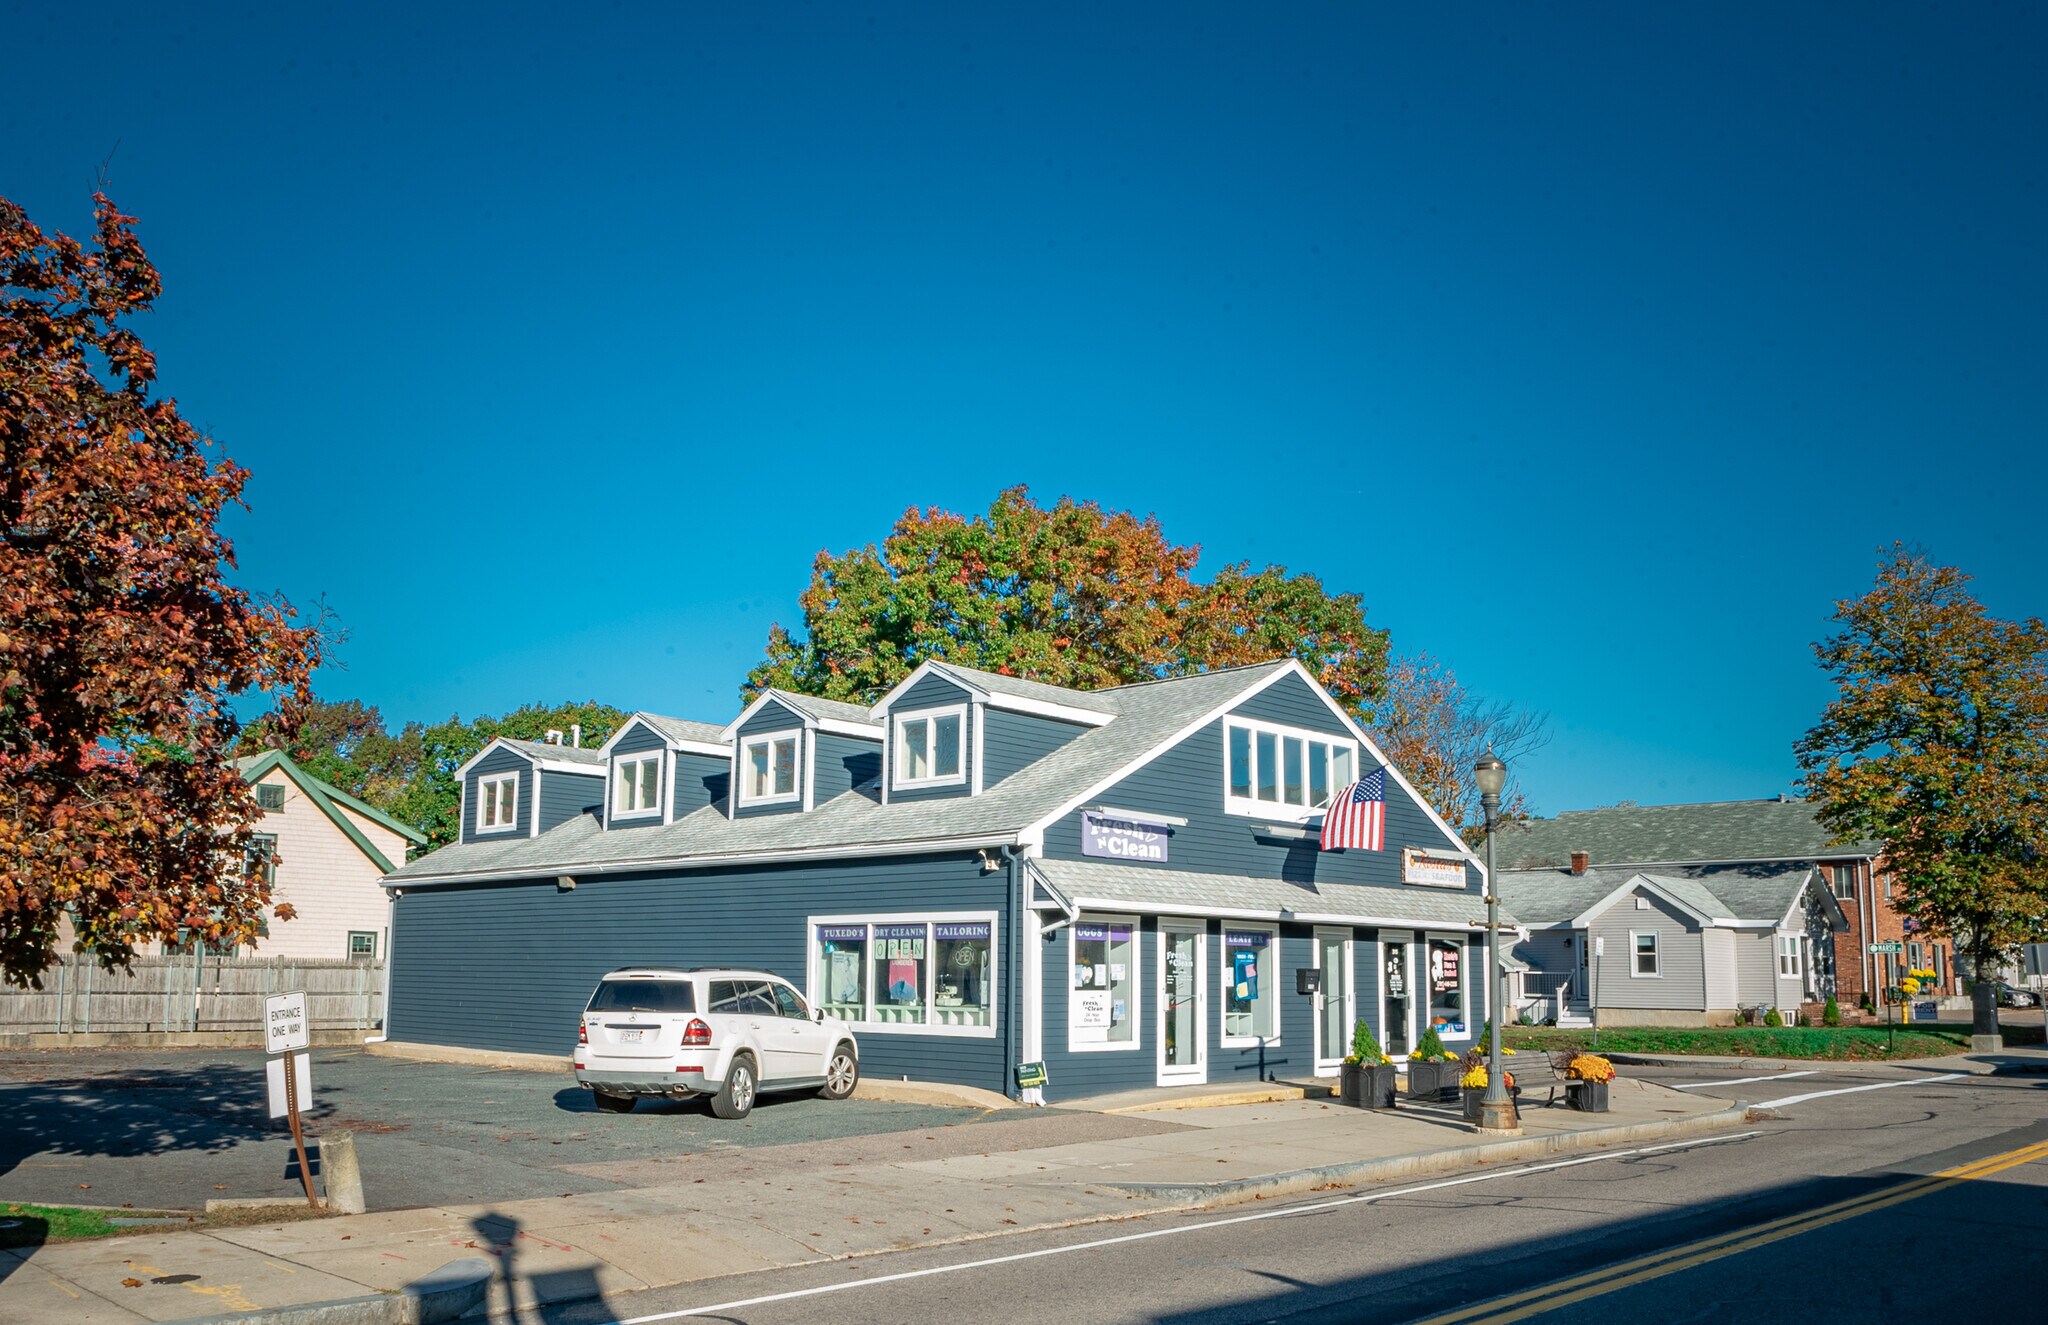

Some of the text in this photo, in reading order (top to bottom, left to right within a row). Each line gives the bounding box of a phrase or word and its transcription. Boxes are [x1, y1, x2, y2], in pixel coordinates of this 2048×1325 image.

[1091, 818, 1144, 840] Fresh
[1108, 836, 1161, 858] Clean
[824, 929, 864, 937] TUXEDO'S
[875, 928, 889, 936] DRY
[1077, 927, 1103, 937] UGGS
[1228, 934, 1264, 944] LEATHER
[877, 942, 922, 957] OPEN
[955, 950, 975, 962] OPEN
[271, 1007, 301, 1022] ENTRANCE
[272, 1023, 301, 1037] ONE WAY
